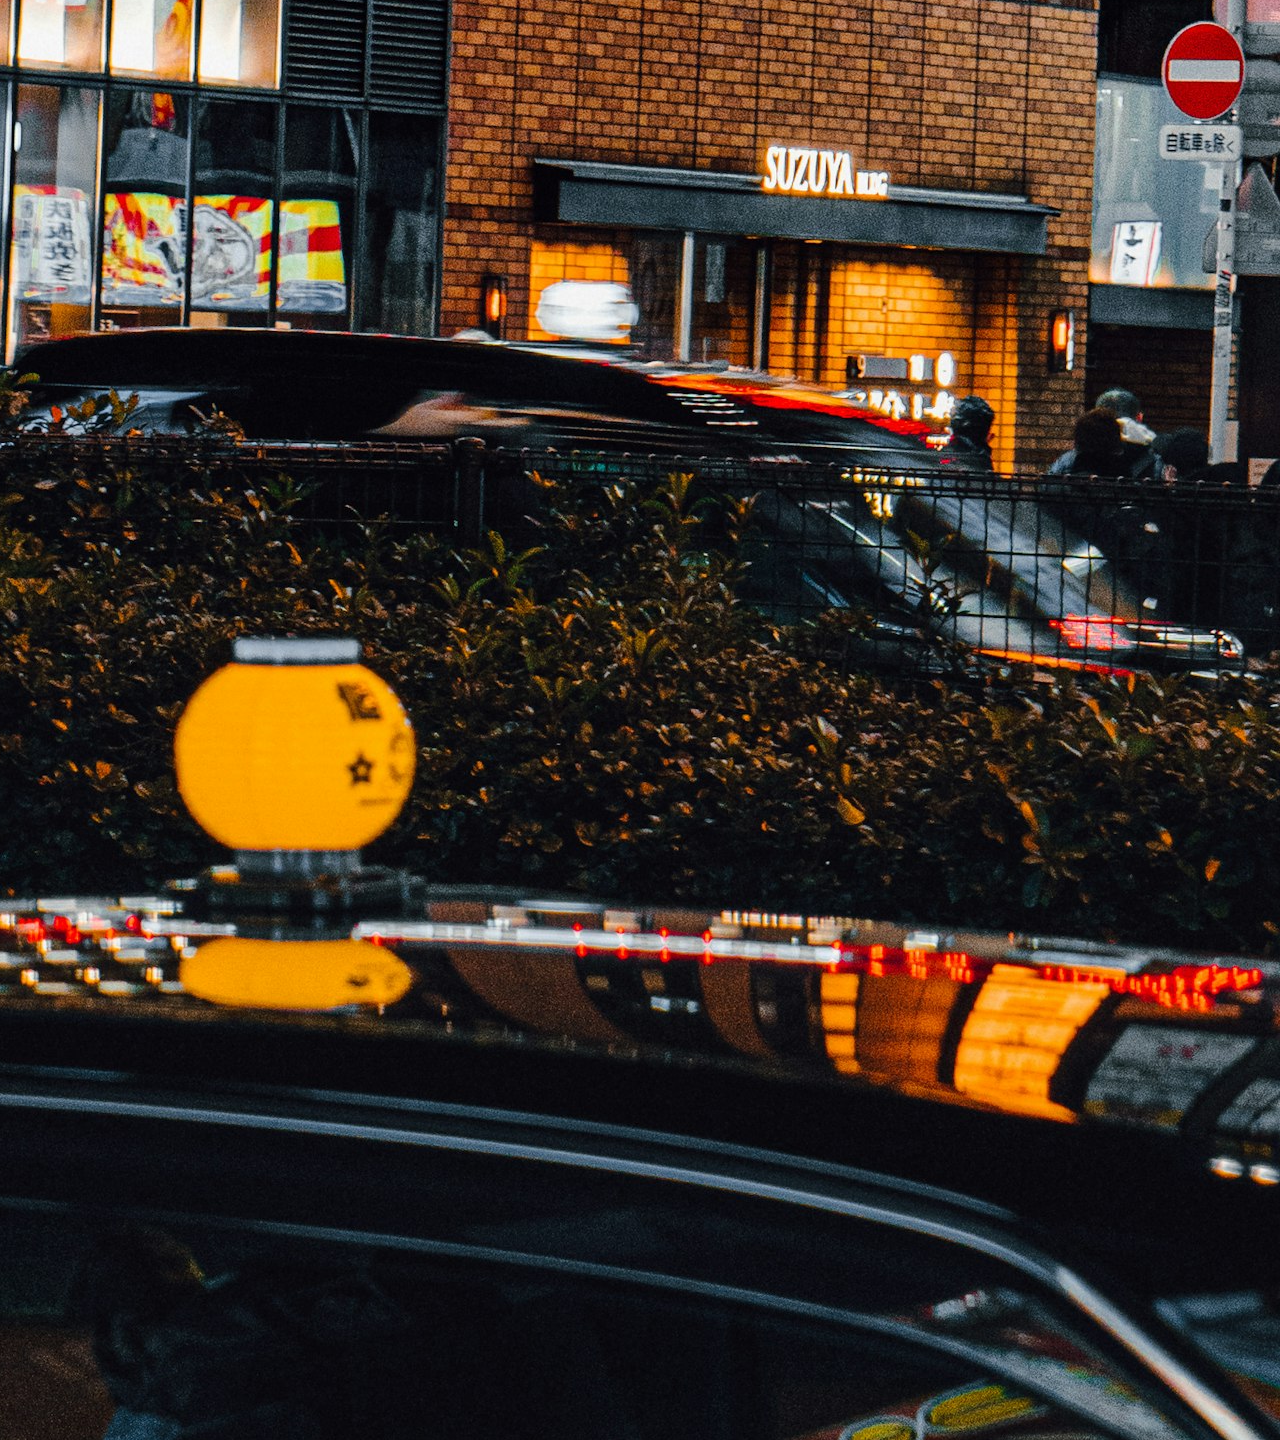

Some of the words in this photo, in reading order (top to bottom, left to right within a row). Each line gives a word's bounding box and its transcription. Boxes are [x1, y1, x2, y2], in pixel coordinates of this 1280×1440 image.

[1165, 129, 1235, 156] 自転車を除く
[764, 142, 854, 195] SUZUYA
